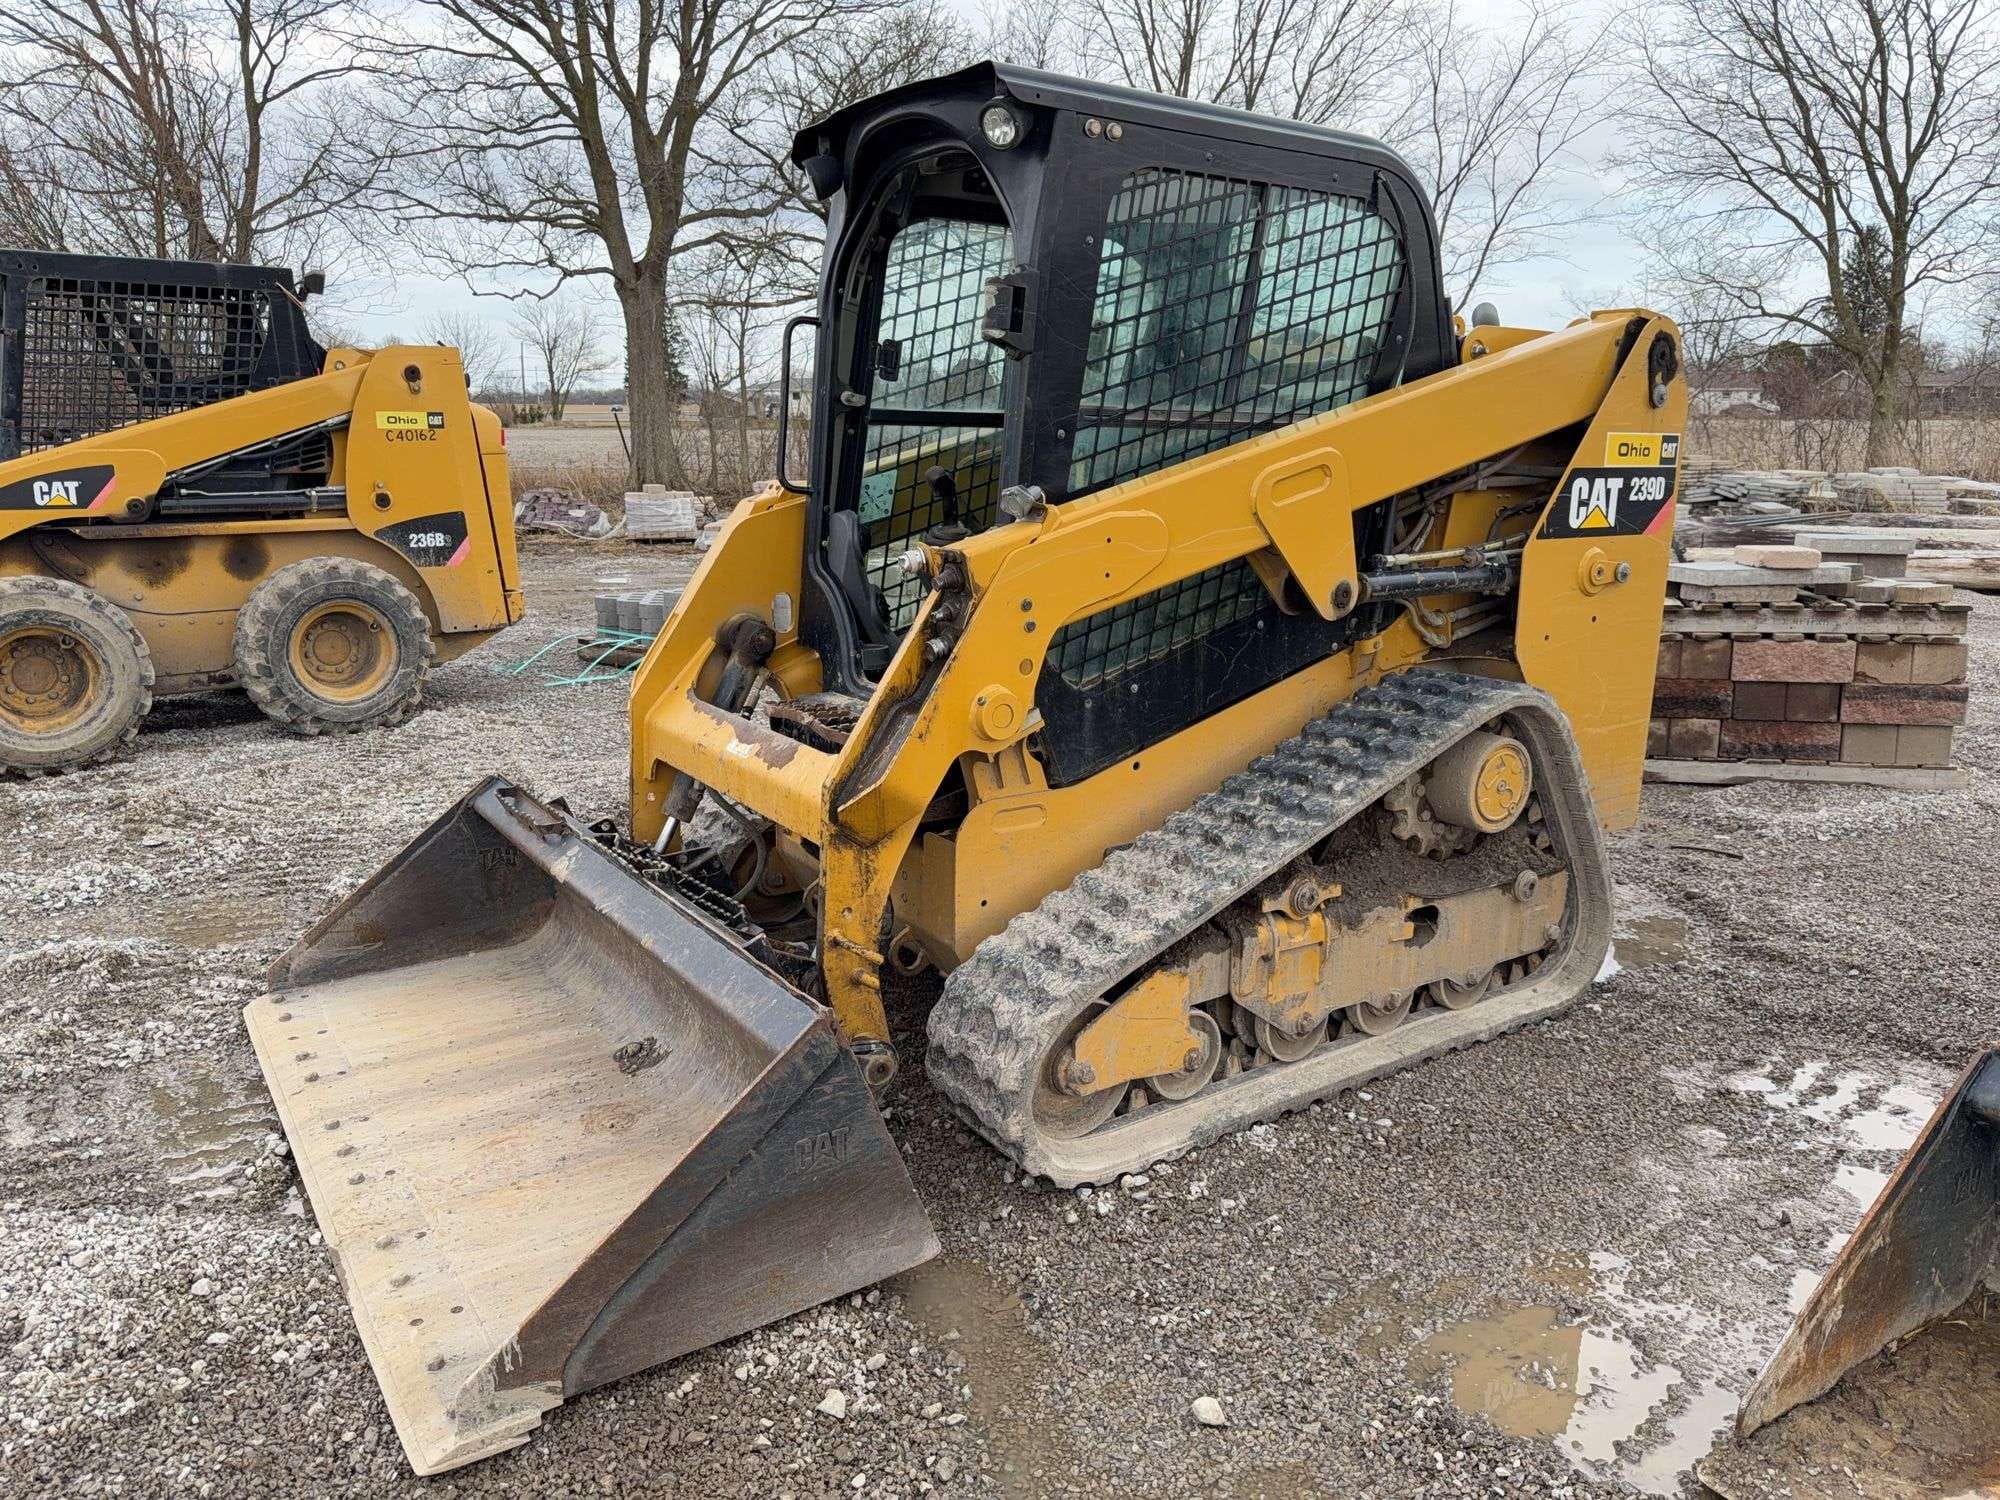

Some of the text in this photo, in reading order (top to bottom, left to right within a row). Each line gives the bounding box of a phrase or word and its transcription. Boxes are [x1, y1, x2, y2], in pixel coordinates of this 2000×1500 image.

[386, 415, 443, 425] Ohio CAT
[385, 429, 437, 442] C40162
[1617, 442, 1677, 458] Ohio CAT
[32, 480, 79, 507] CAT
[1568, 476, 1666, 529] CAT 239D
[794, 1126, 850, 1170] CAT
